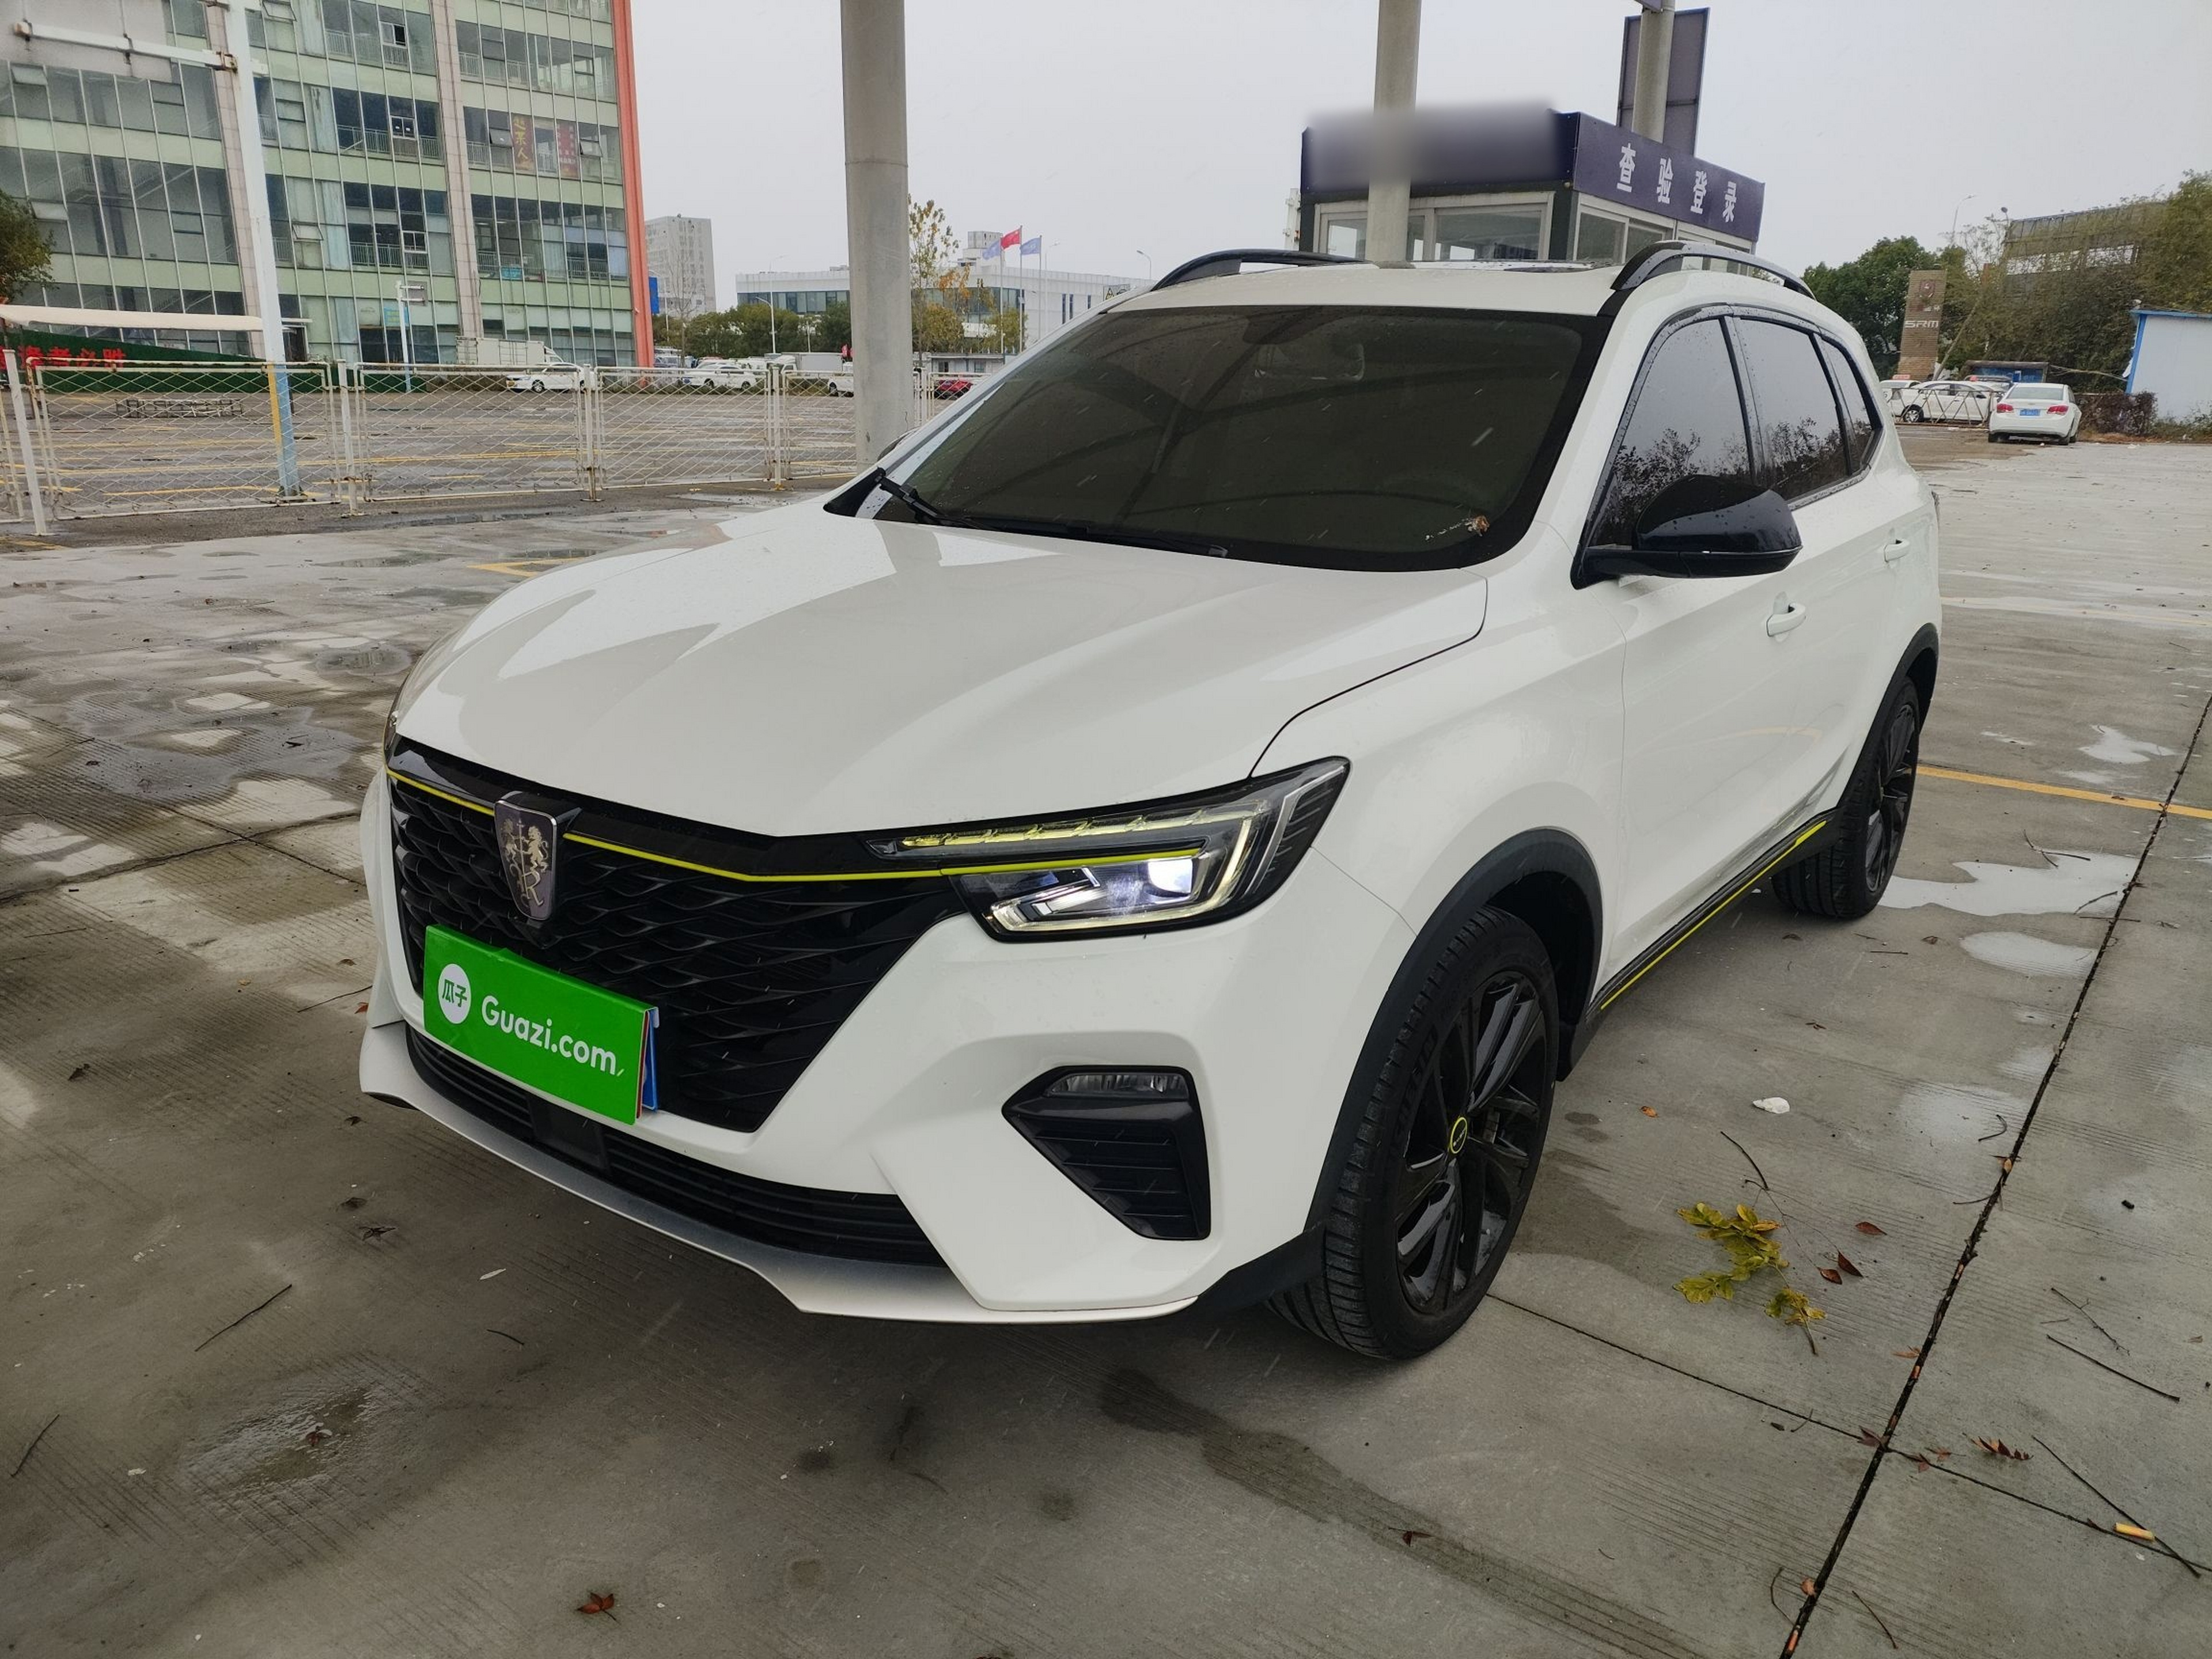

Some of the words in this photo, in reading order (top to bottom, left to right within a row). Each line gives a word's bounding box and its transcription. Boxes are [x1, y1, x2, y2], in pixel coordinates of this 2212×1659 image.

[1616, 143, 1737, 222] 查验登录
[441, 979, 467, 1007] 瓜子
[482, 995, 616, 1075] Guazi.com
